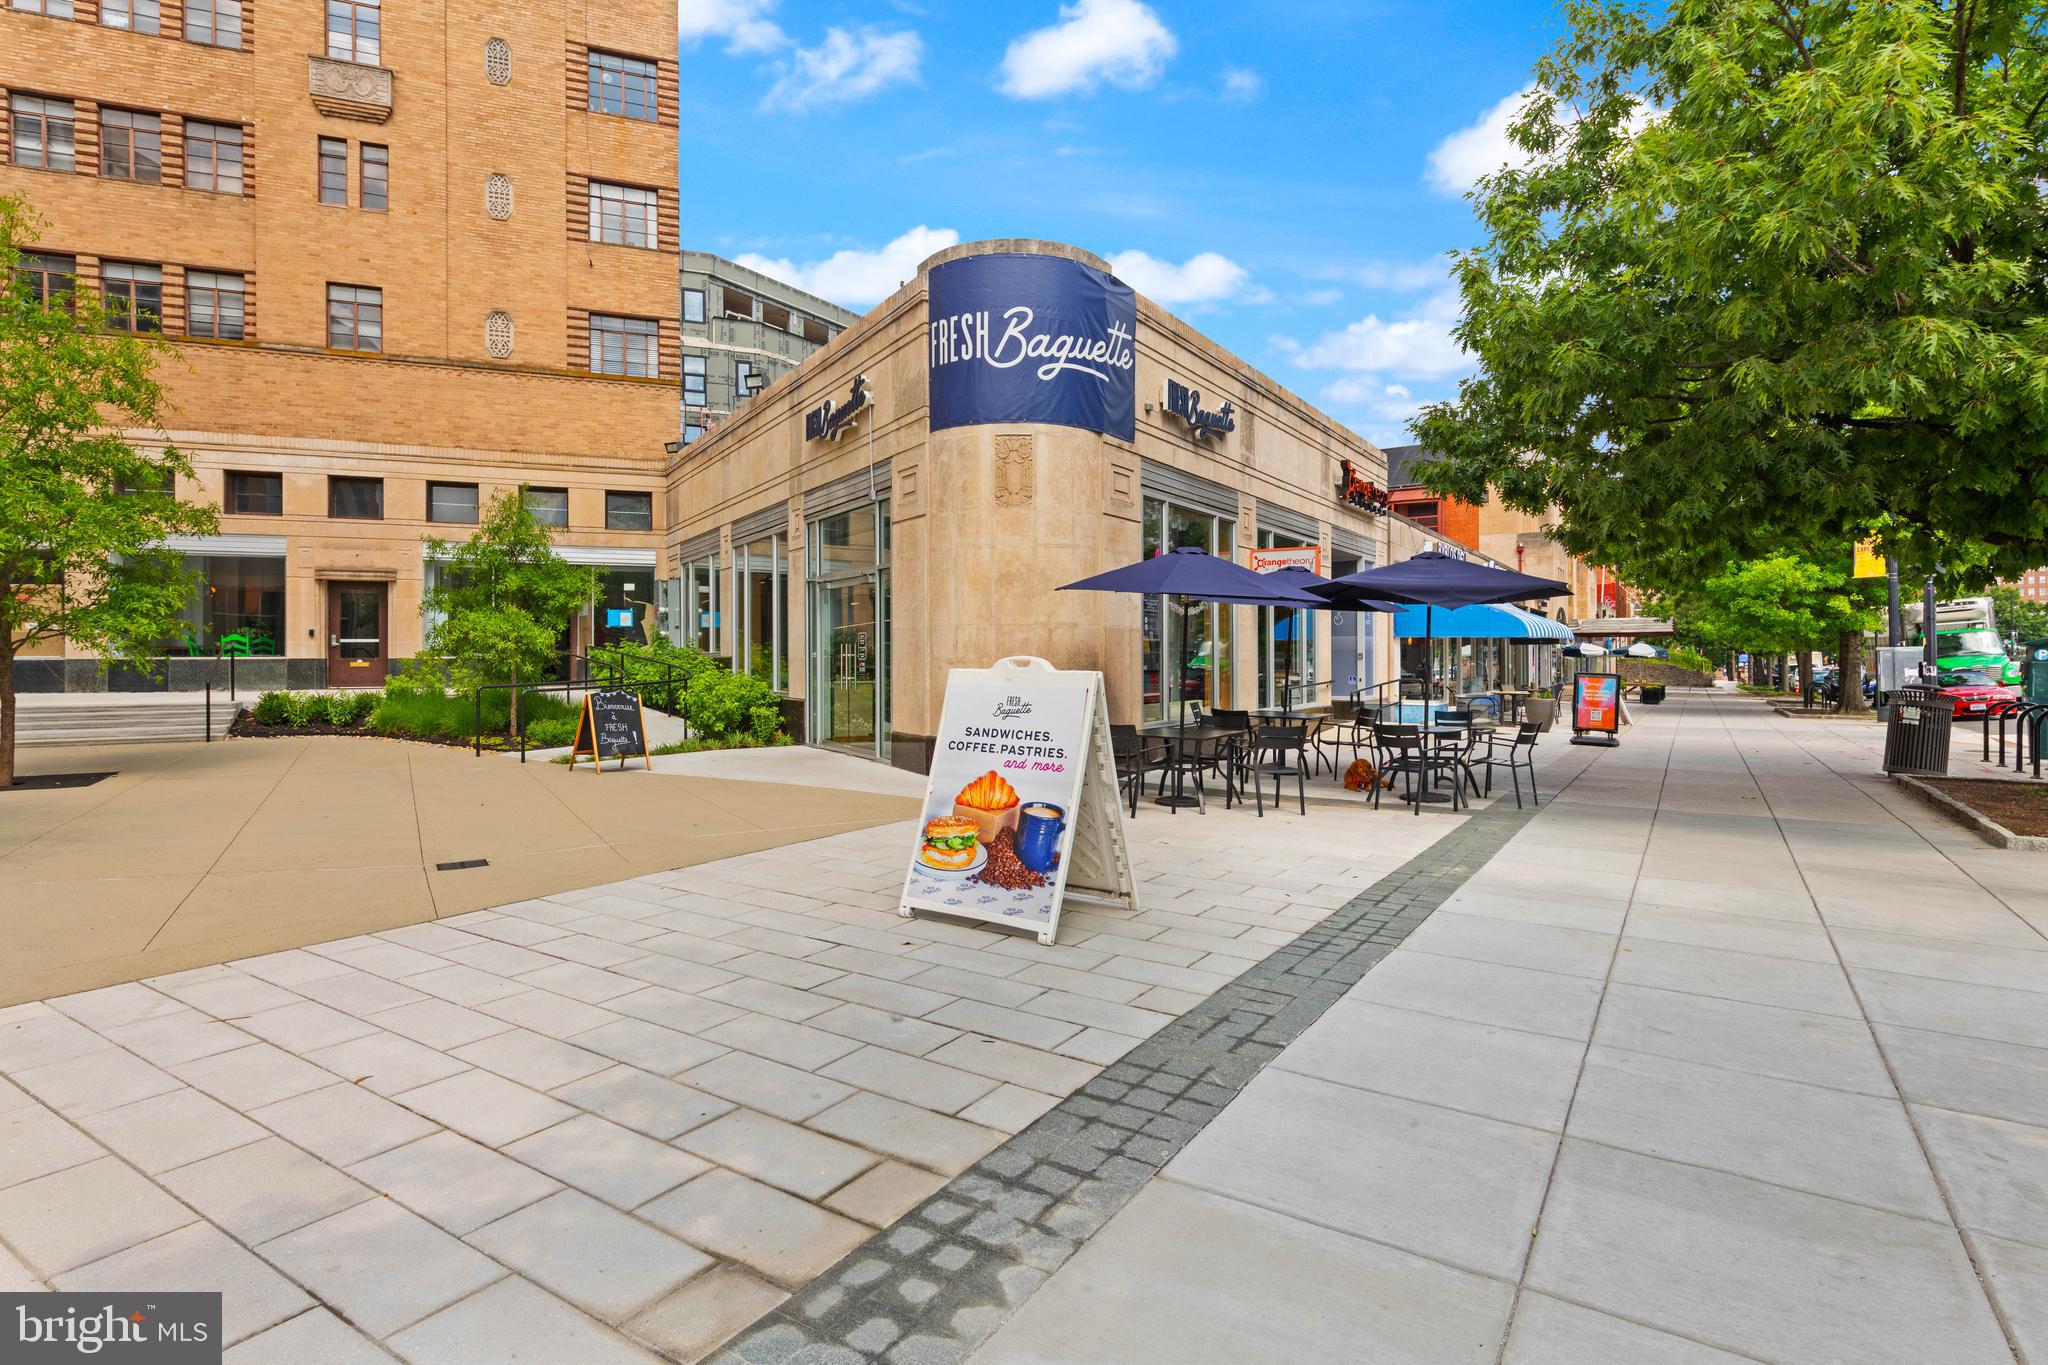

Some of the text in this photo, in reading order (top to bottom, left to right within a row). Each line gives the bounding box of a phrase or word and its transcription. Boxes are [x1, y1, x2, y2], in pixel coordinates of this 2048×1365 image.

[931, 306, 1133, 383] FRESH Baguette
[992, 702, 1032, 720] Baguette
[604, 723, 628, 732] FRESH
[965, 727, 1054, 742] SANDWICHES.
[1003, 758, 1065, 773] and more
